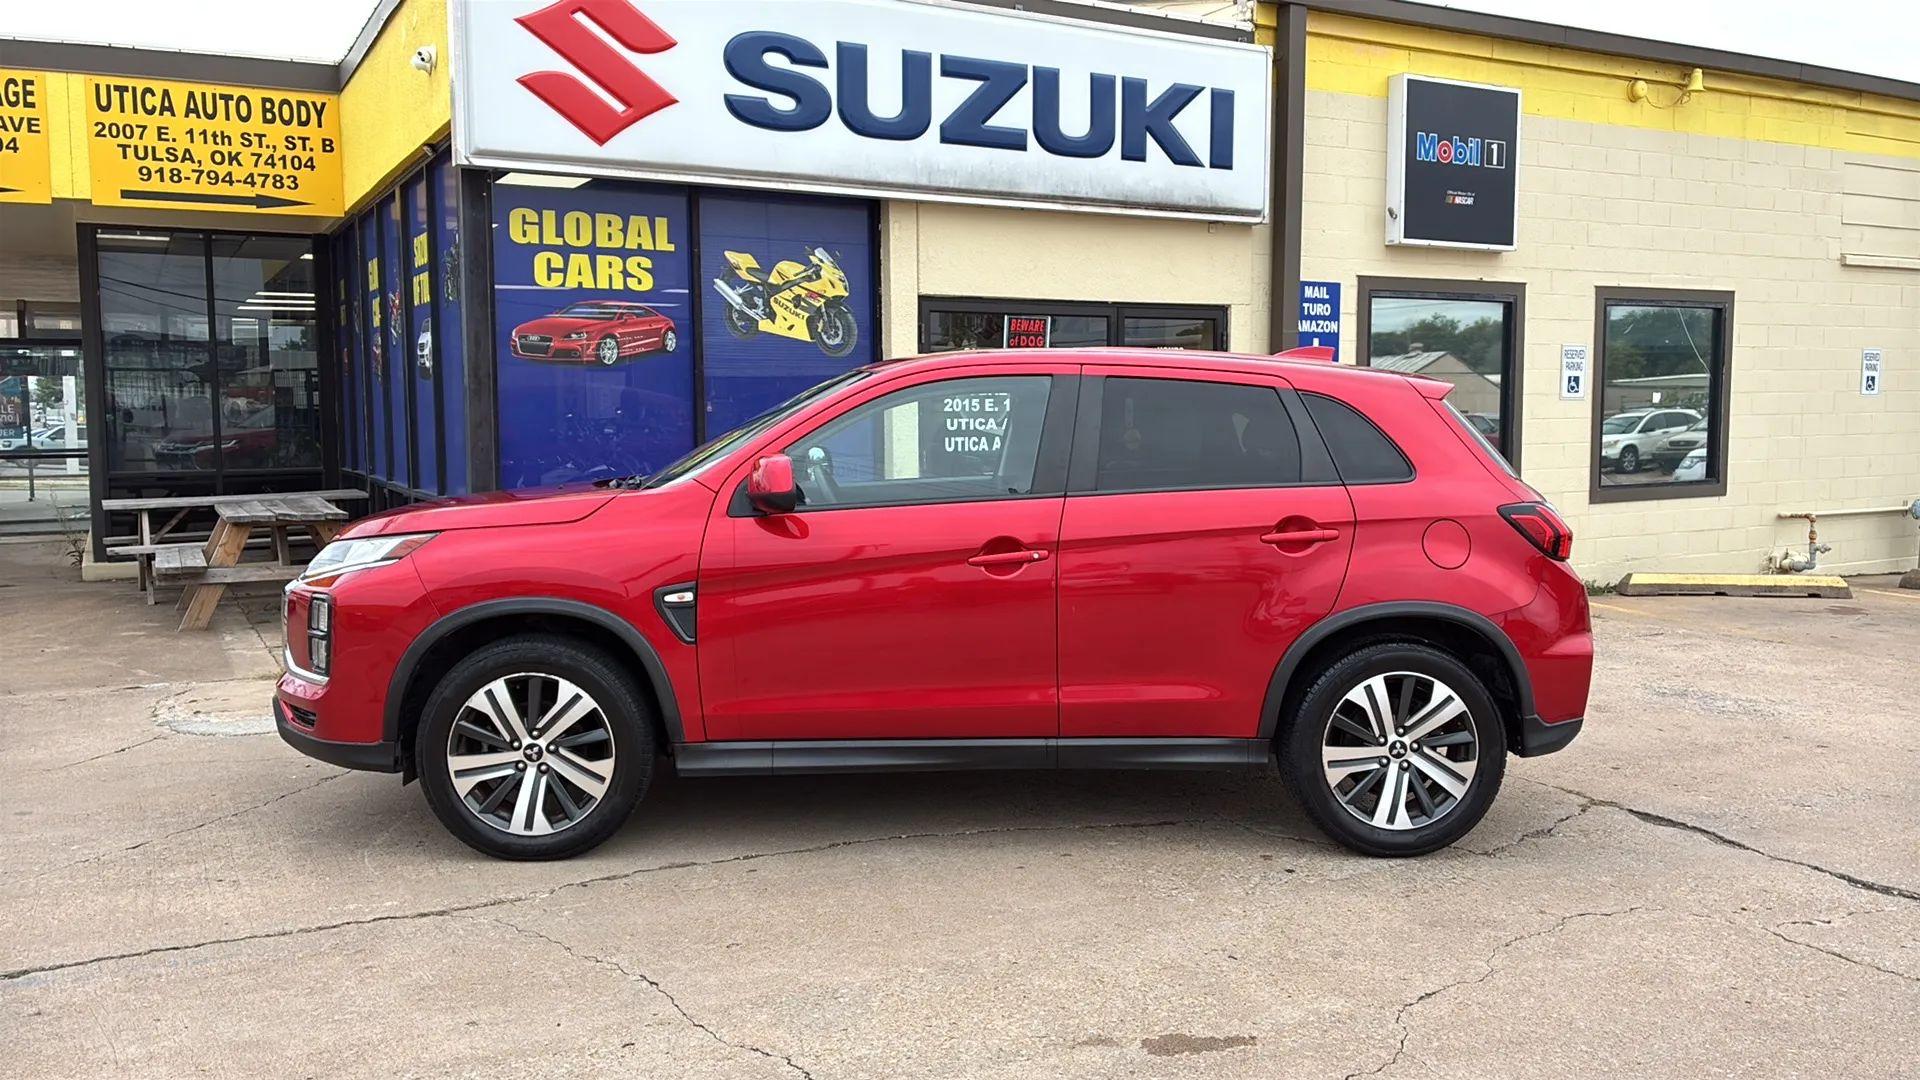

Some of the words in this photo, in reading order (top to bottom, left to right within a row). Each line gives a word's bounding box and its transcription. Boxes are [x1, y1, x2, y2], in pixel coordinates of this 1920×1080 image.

[0, 77, 36, 109] GE
[94, 83, 176, 117] UTICA
[184, 90, 252, 123] AUTO
[261, 97, 327, 128] BODY
[723, 30, 1235, 170] SUZUKI
[94, 121, 148, 140] 2007
[156, 126, 177, 142] E.
[185, 128, 232, 146] 11th
[240, 132, 277, 153] ST.,
[284, 135, 314, 152] ST.
[321, 138, 335, 153] B
[1416, 131, 1481, 166] Mobil
[117, 143, 202, 167] TULSA,
[210, 150, 243, 167] OK
[250, 152, 316, 171] 74104
[138, 165, 299, 190] 918-794-4783
[509, 207, 676, 252] GLOBAL
[534, 251, 655, 291] CARS
[1304, 286, 1329, 299] MAIL
[773, 297, 805, 320] SUZUKI
[1302, 303, 1331, 316] TURO
[1010, 318, 1045, 333] BEWARE
[1009, 338, 1018, 348] of
[1019, 336, 1044, 348] DOG
[944, 398, 980, 412] 2015
[985, 398, 999, 412] E.
[946, 418, 998, 431] UTICA
[944, 436, 989, 452] UTICA
